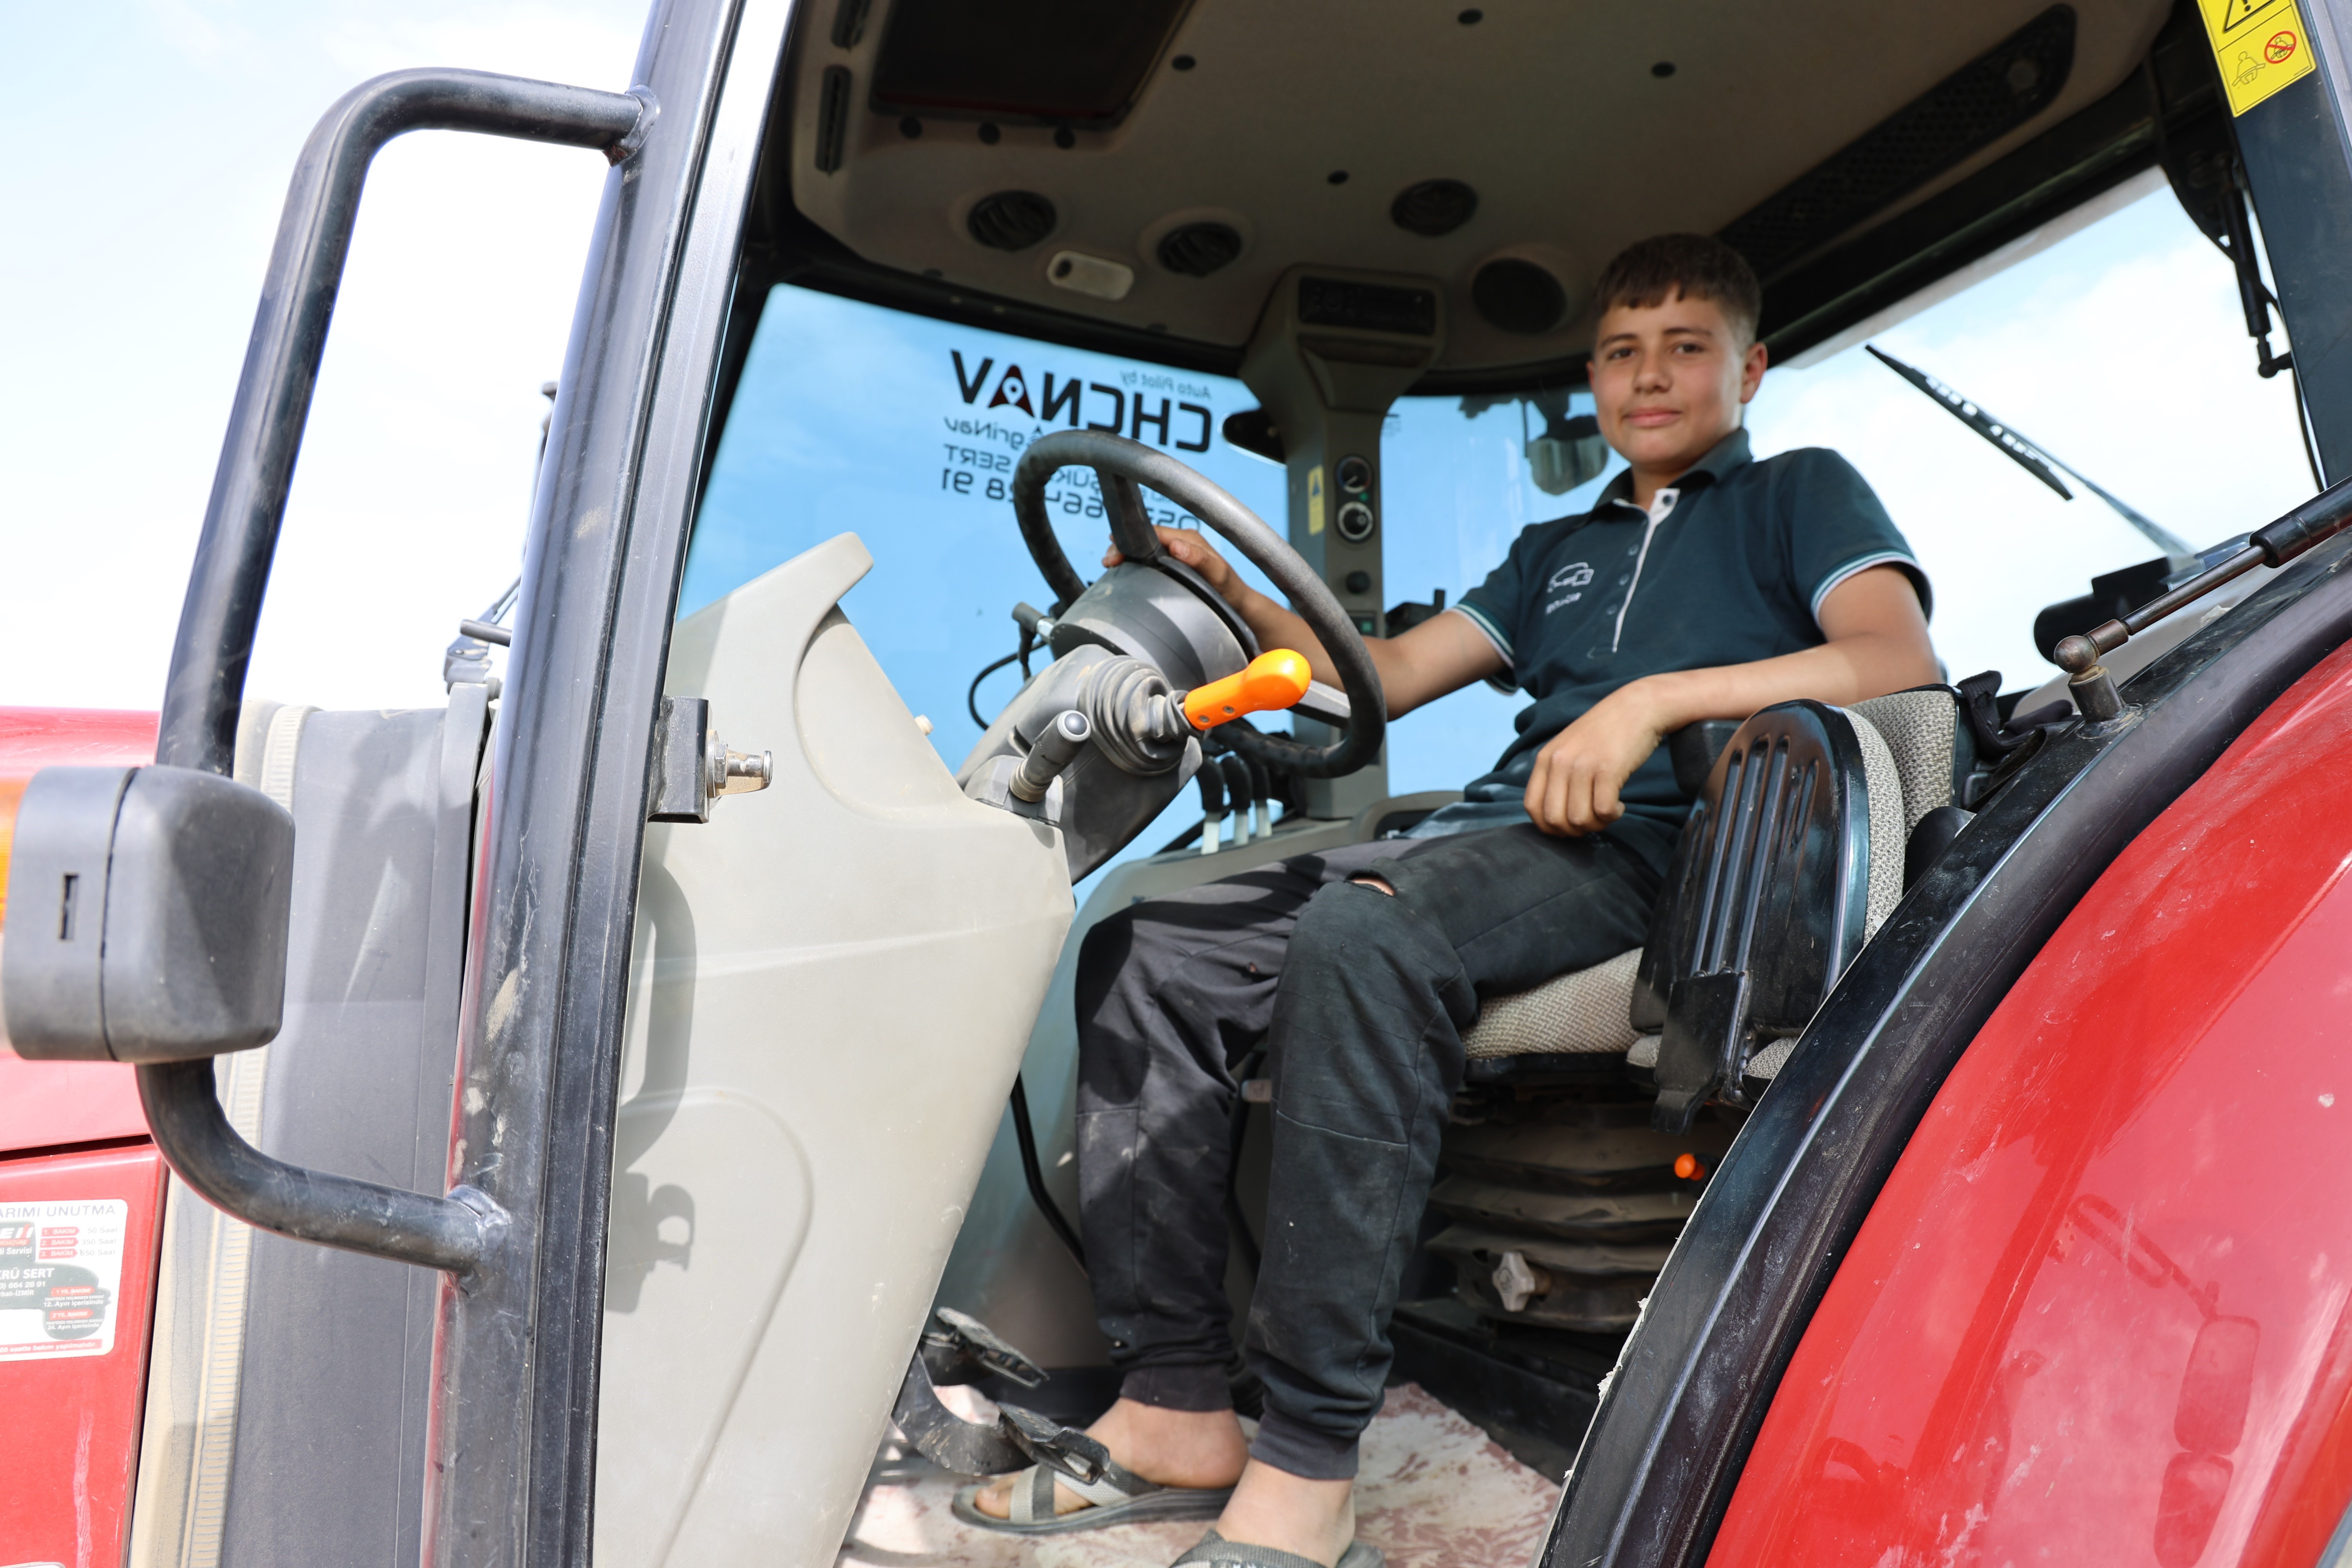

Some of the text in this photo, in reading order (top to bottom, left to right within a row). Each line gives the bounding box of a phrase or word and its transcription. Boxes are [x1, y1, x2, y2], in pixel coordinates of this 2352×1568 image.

[46, 1205, 115, 1217] UNUTMA
[7, 1247, 33, 1255] Servisi
[23, 1268, 55, 1279] SERT
[72, 1299, 104, 1307] içerisinde
